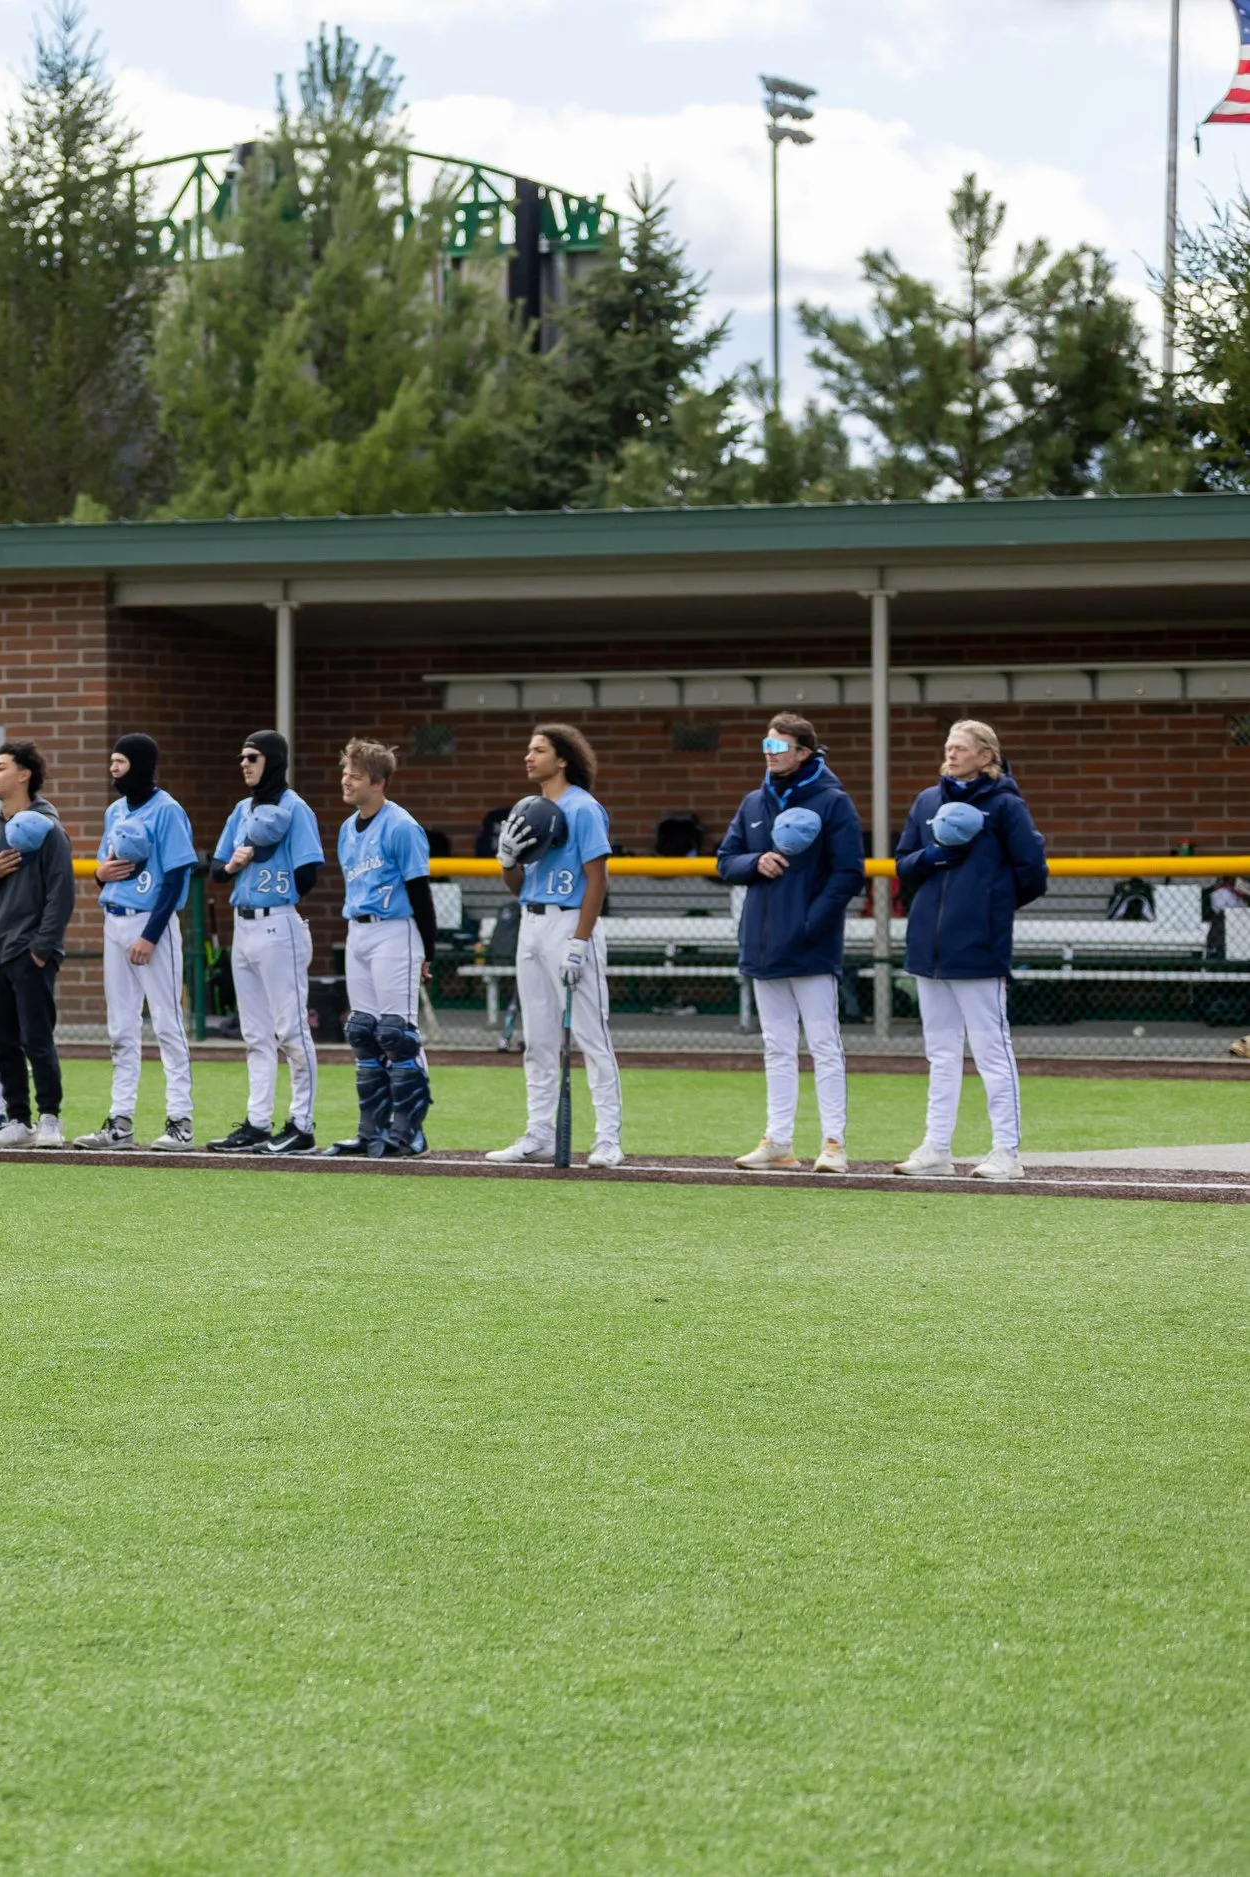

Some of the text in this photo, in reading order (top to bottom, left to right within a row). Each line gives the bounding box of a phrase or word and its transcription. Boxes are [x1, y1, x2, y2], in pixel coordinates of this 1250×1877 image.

[136, 870, 152, 893] 9
[257, 868, 290, 894] 25
[545, 869, 574, 895] 13
[377, 885, 394, 909] 7
